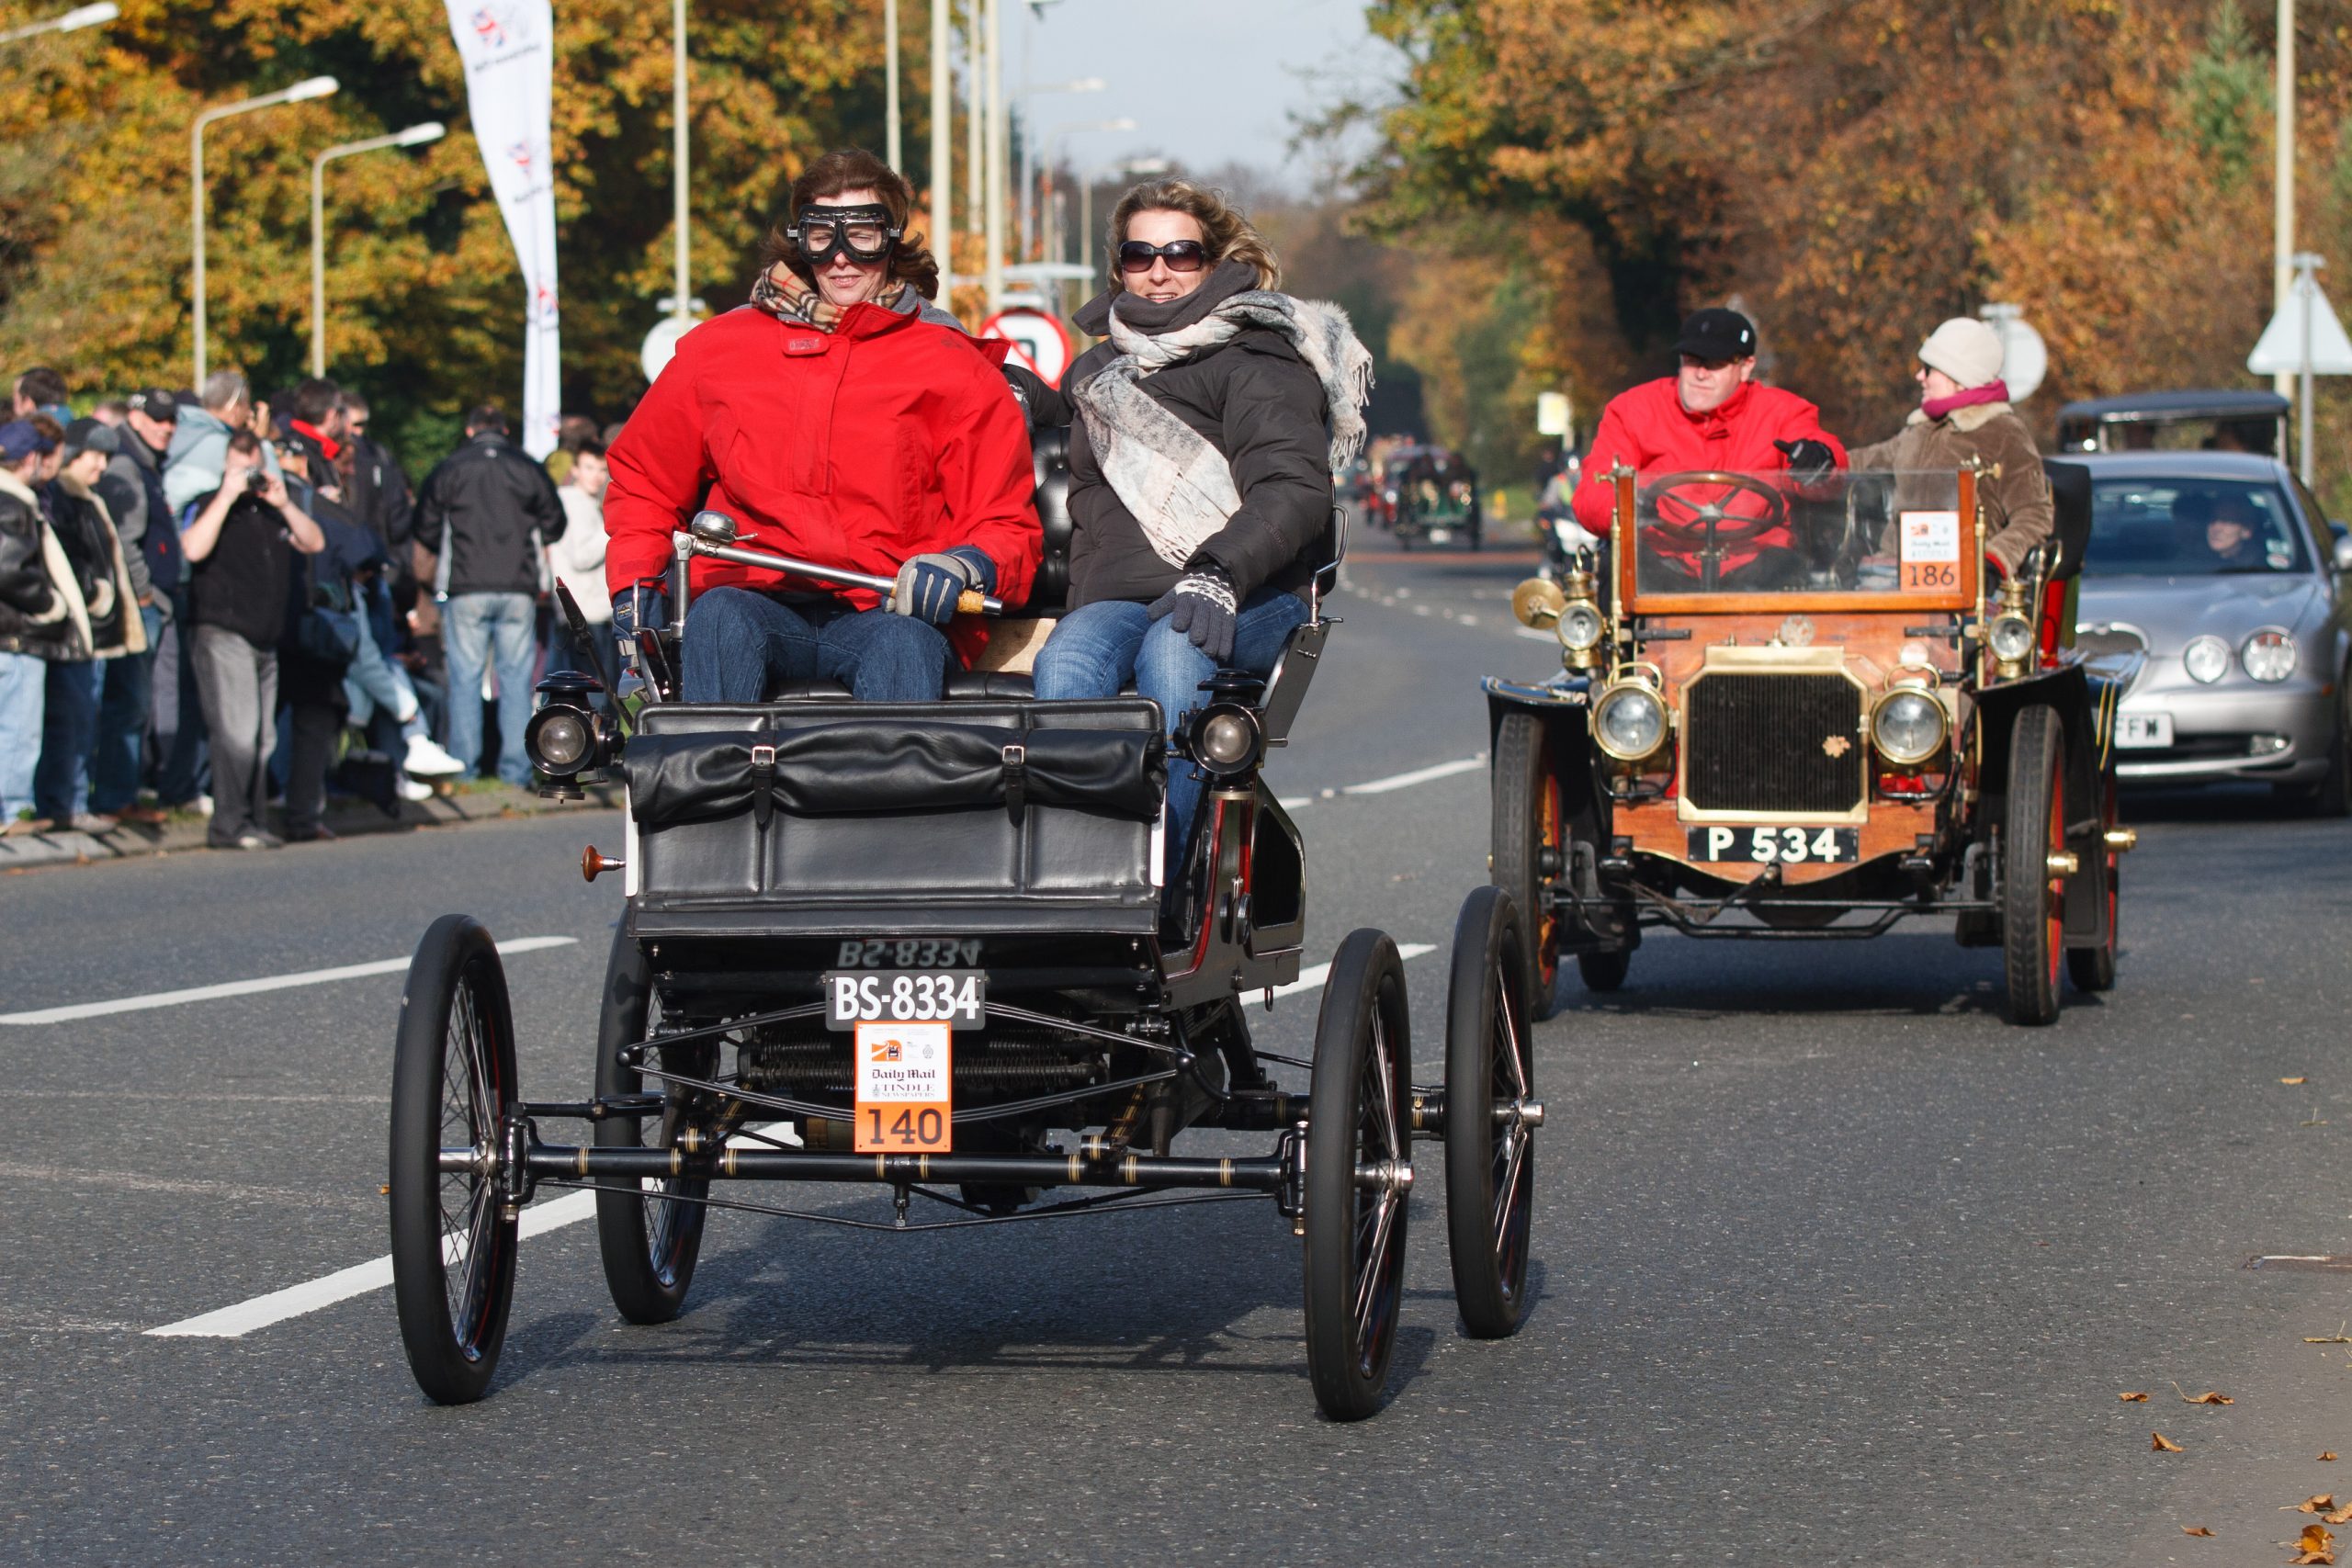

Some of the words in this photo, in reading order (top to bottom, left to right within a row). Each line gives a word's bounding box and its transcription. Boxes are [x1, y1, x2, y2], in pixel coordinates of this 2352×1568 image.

[1909, 565, 1955, 586] 186
[1708, 827, 1735, 862] P
[1750, 827, 1841, 863] 534
[835, 975, 980, 1021] BS-8334
[872, 1069, 905, 1081] Daily
[907, 1069, 935, 1078] Mail
[868, 1108, 943, 1145] 140
